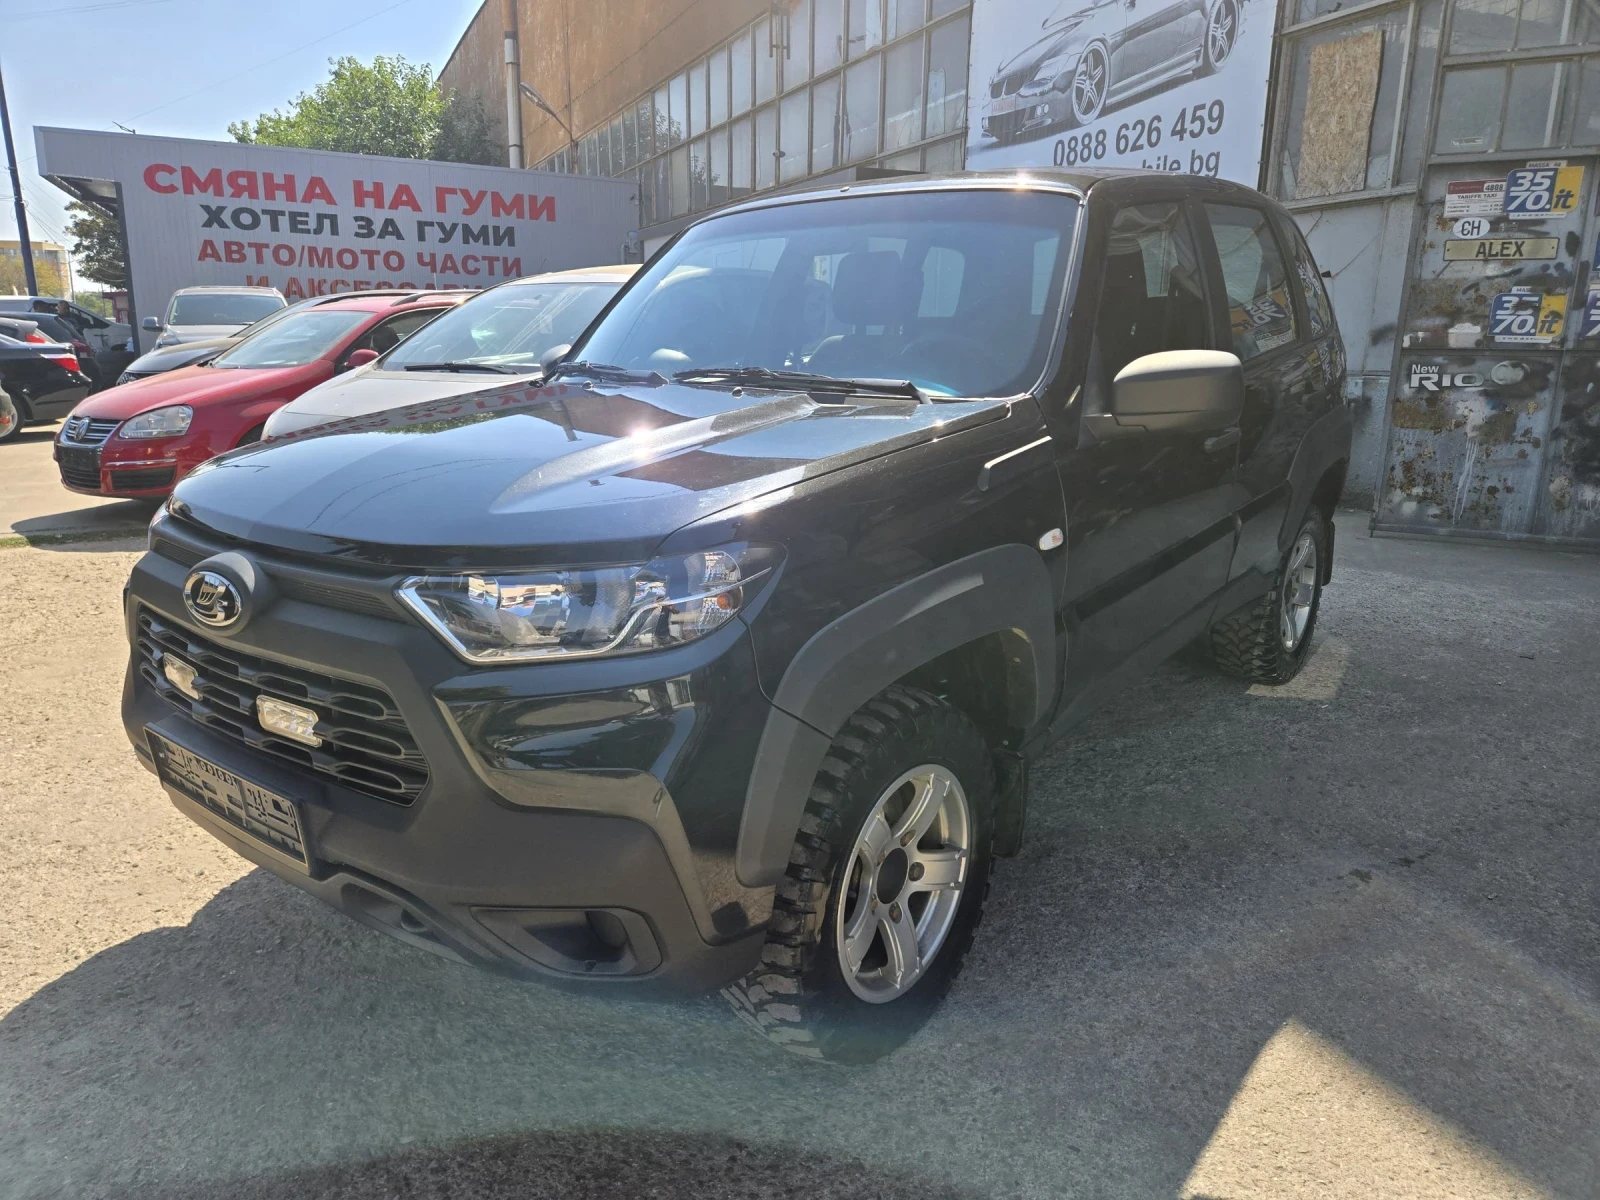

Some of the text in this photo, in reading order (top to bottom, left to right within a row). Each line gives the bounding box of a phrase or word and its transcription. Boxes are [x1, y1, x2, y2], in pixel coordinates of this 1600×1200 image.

[1053, 99, 1225, 167] 0888 626 459
[1510, 171, 1555, 191] 35
[143, 163, 556, 222] СМЯНА НА ГУМИ
[199, 204, 516, 247] ХОТЕЛ ЗА ГУМИ
[1460, 220, 1482, 237] CH
[197, 239, 522, 278] АВТО/МОТО ЧАСТИ
[1475, 241, 1525, 258] ALEX
[1411, 364, 1440, 374] New
[1409, 373, 1485, 391] RIO
